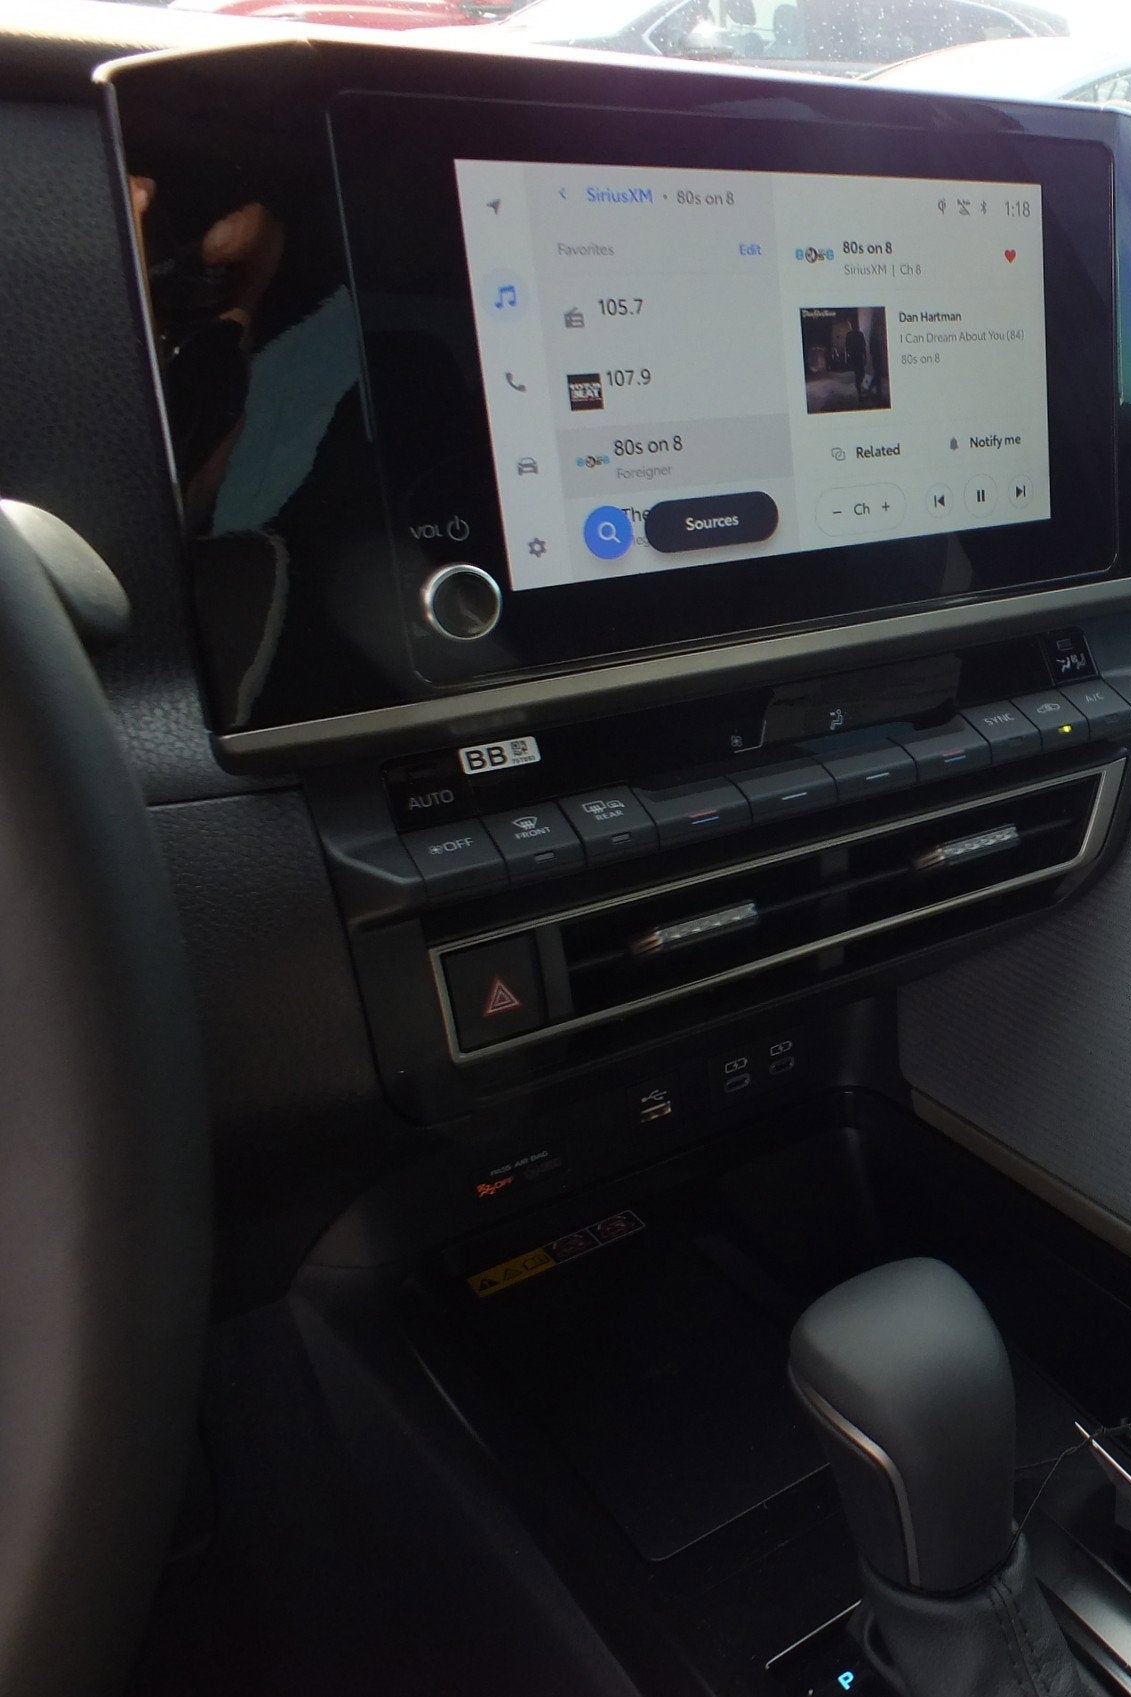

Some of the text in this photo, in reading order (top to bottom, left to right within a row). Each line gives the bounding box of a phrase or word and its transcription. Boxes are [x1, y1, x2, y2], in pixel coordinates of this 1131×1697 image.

[586, 187, 735, 206] SiriusXM 80s on 8
[1004, 201, 1031, 218] 1:18
[557, 243, 615, 256] Favorites
[739, 243, 762, 257] Edit
[843, 241, 893, 255] 80s on 8
[844, 264, 922, 276] SiriusXM Ch 8
[598, 299, 643, 316] 105.7
[899, 311, 962, 323] Dan Hartman
[905, 333, 924, 344] Can
[927, 332, 957, 344] Dream
[959, 330, 987, 342] About
[988, 330, 1005, 342] You
[1006, 329, 1025, 342] (84)
[901, 353, 941, 365] 80s on 8
[606, 369, 651, 386] 107.9
[613, 435, 683, 457] 80s on 8
[969, 434, 1021, 450] Notify me
[856, 443, 901, 459] Related
[616, 465, 673, 482] Foreigner
[853, 502, 871, 516] Ch
[685, 514, 739, 532] Sources
[409, 524, 443, 540] VOL
[1085, 690, 1105, 703] A/C
[984, 711, 1015, 727] SYNC
[465, 745, 509, 771] BB
[409, 789, 454, 812] AUTO
[595, 809, 624, 821] REAR
[515, 825, 550, 840] FRONT
[443, 837, 474, 853] OFF
[837, 1671, 854, 1691] P
